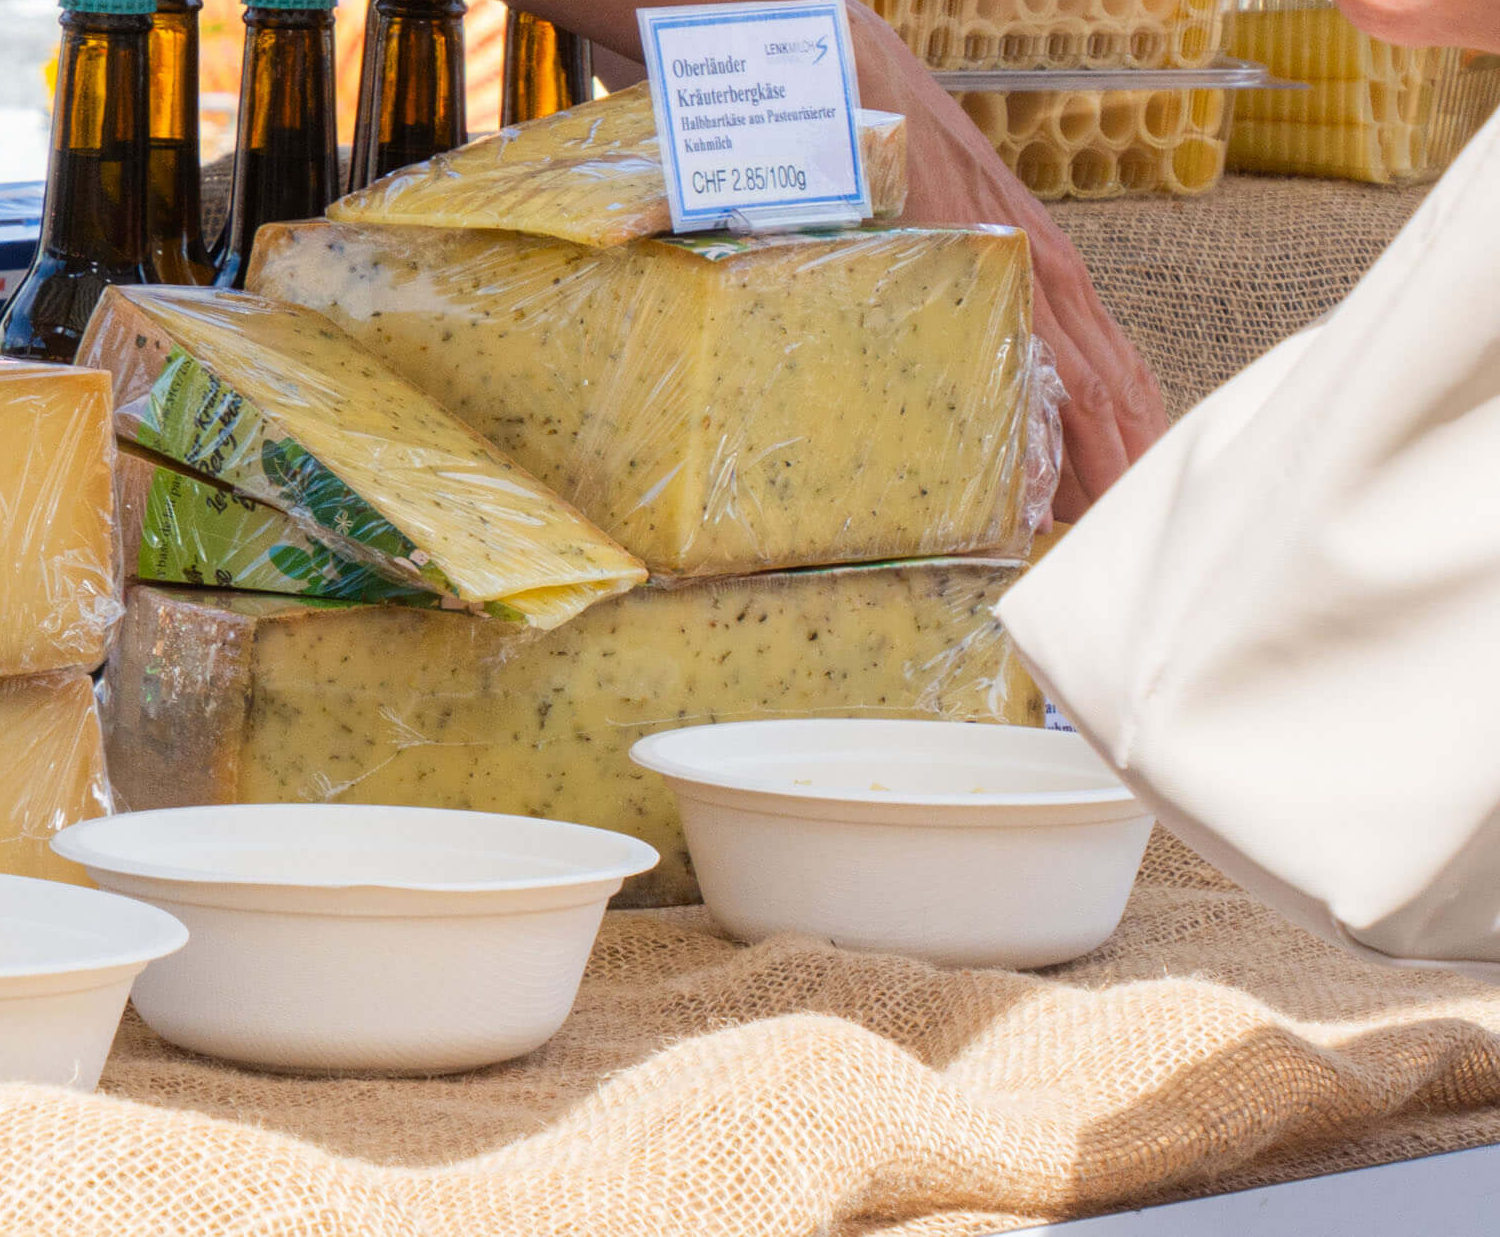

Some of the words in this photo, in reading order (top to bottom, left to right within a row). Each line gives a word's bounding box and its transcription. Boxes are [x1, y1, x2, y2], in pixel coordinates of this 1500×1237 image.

[672, 57, 747, 78] Oberländer
[677, 83, 786, 108] Kräuterbergkäse
[681, 111, 746, 131] Halbhartkäse
[749, 113, 765, 125] aus
[767, 106, 836, 124] Pasteurisierter
[684, 136, 733, 153] Kuhmilch
[692, 169, 727, 194] CHF
[732, 164, 807, 191] 2.85/100g
